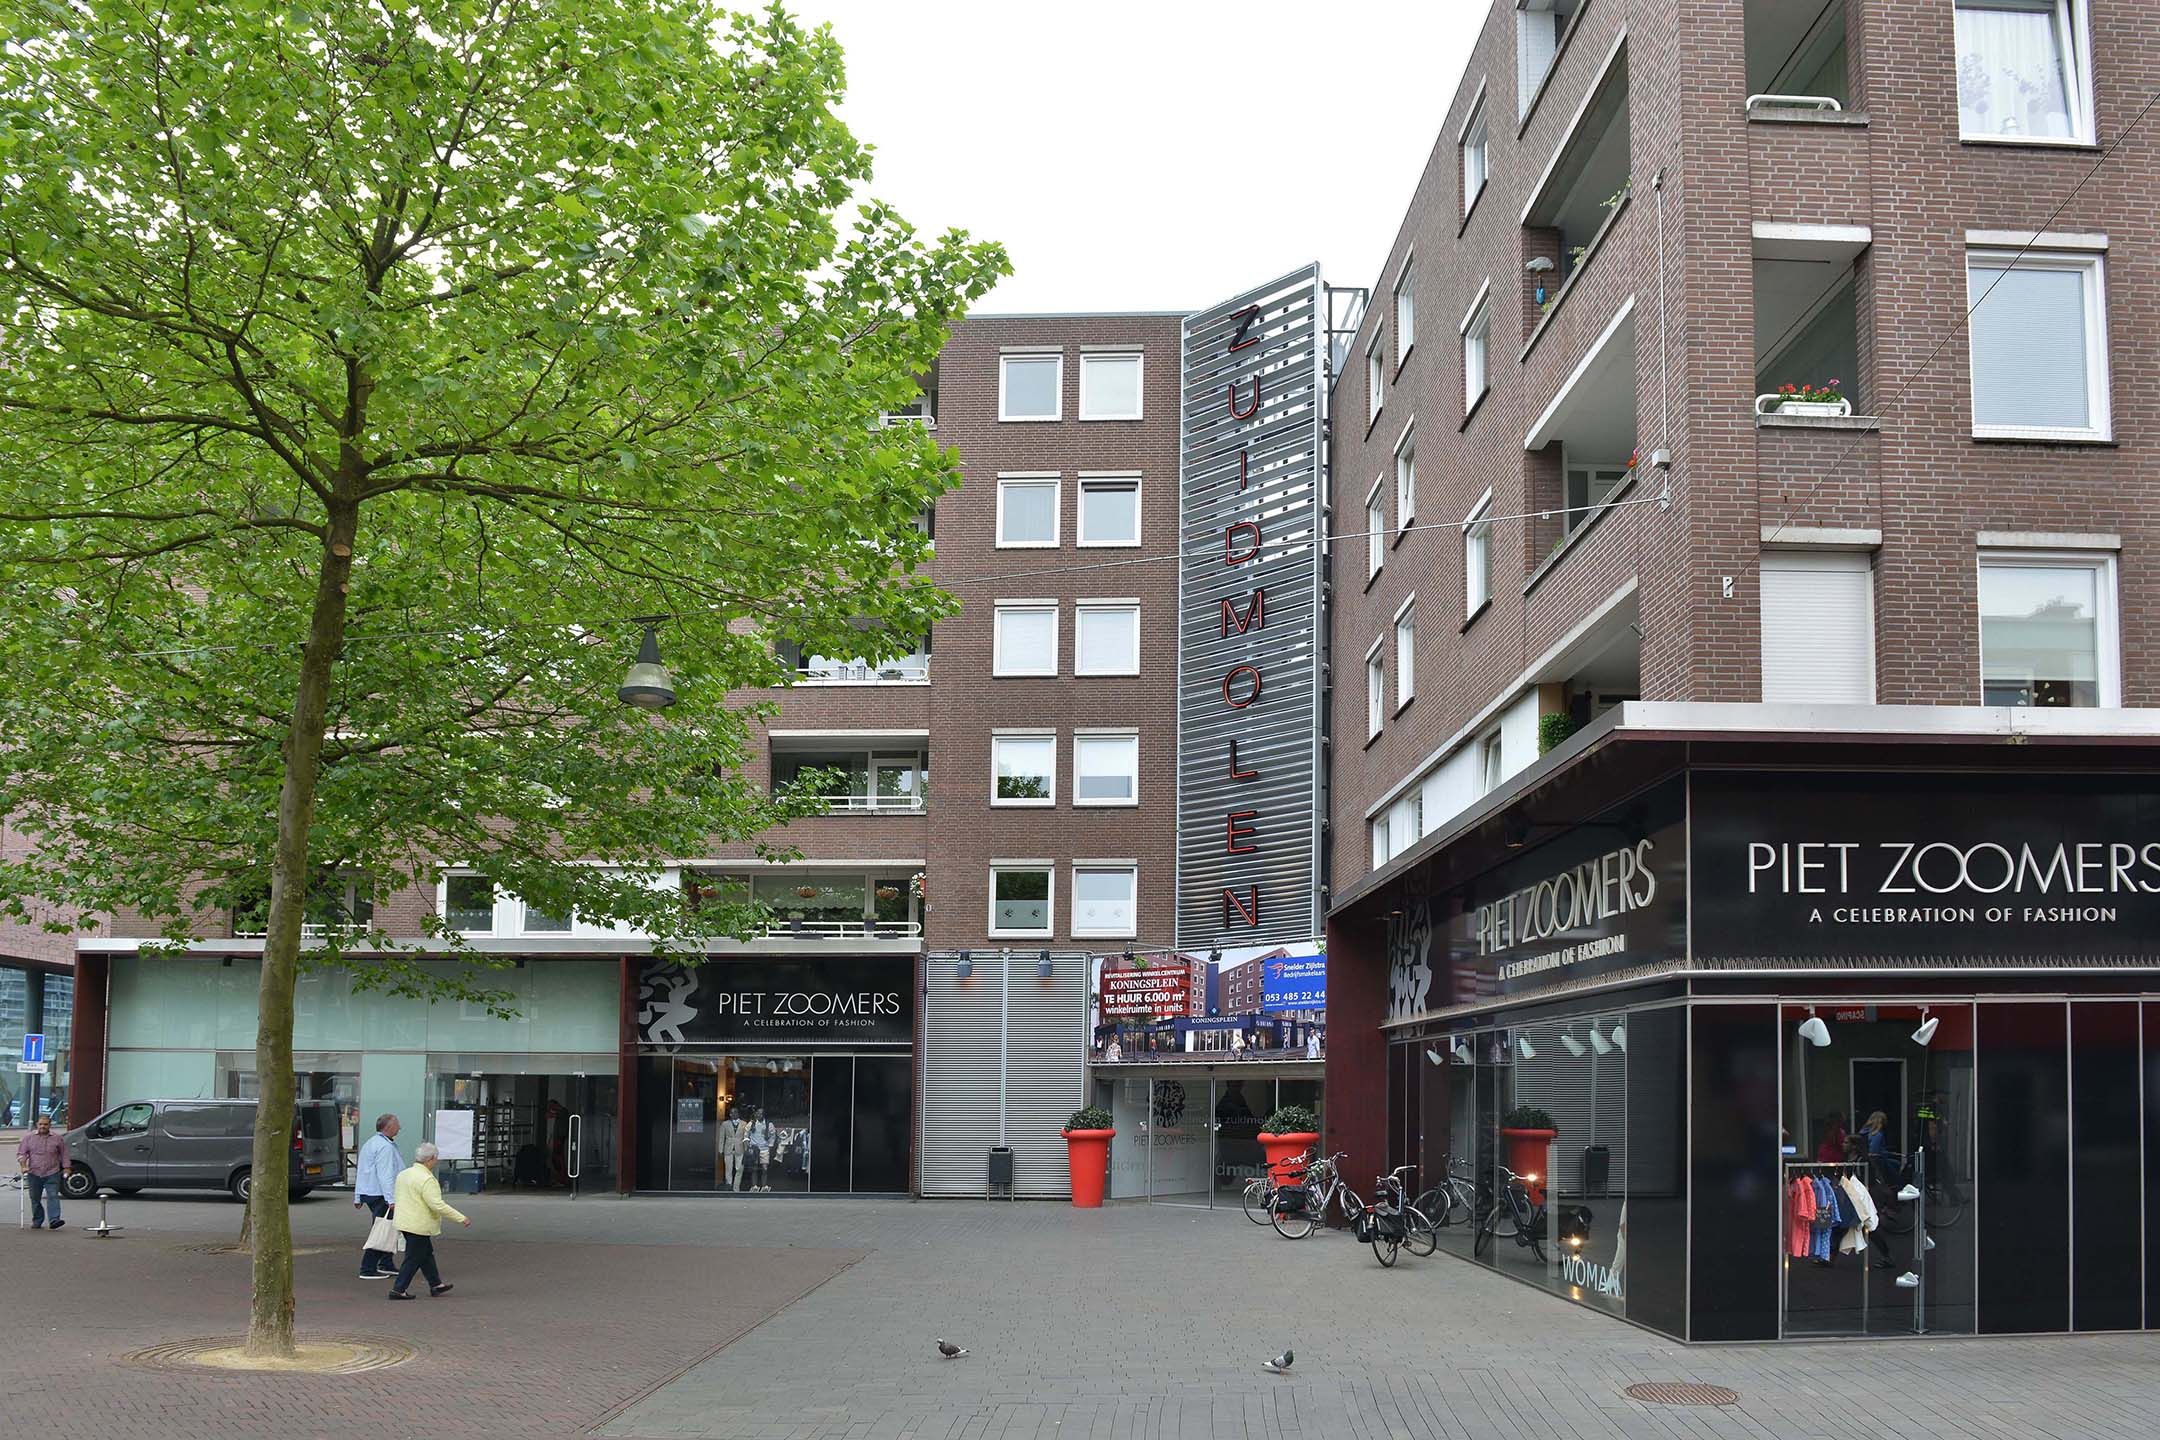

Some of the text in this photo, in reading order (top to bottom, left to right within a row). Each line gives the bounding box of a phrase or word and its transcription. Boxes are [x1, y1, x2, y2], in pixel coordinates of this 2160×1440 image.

[1221, 304, 1265, 929] ZUIDMOLEN
[1748, 842, 2160, 894] PIET ZOOMERS
[1480, 838, 1657, 956] PIET ZOOMERS
[1808, 906, 2117, 923] A CELEBRATION OF FASHION
[1498, 934, 1625, 981] A CELEBRATION OF FASHION
[1110, 977, 1179, 990] KONINGSPLEIN
[1104, 994, 1115, 1004] TE
[1116, 993, 1143, 1004] HUUR
[1144, 992, 1170, 1002] 6.000
[1265, 990, 1326, 1001] 053 485 22 44
[719, 992, 900, 1015] PIET ZOOMERS
[1105, 1002, 1183, 1014] winkelruimte in units
[743, 1019, 876, 1027] A CELEBRATION OF FASHION
[1191, 1016, 1239, 1024] KONINGSPLEIN
[1133, 1134, 1151, 1147] PIET
[1562, 1253, 1622, 1297] WOMAN
